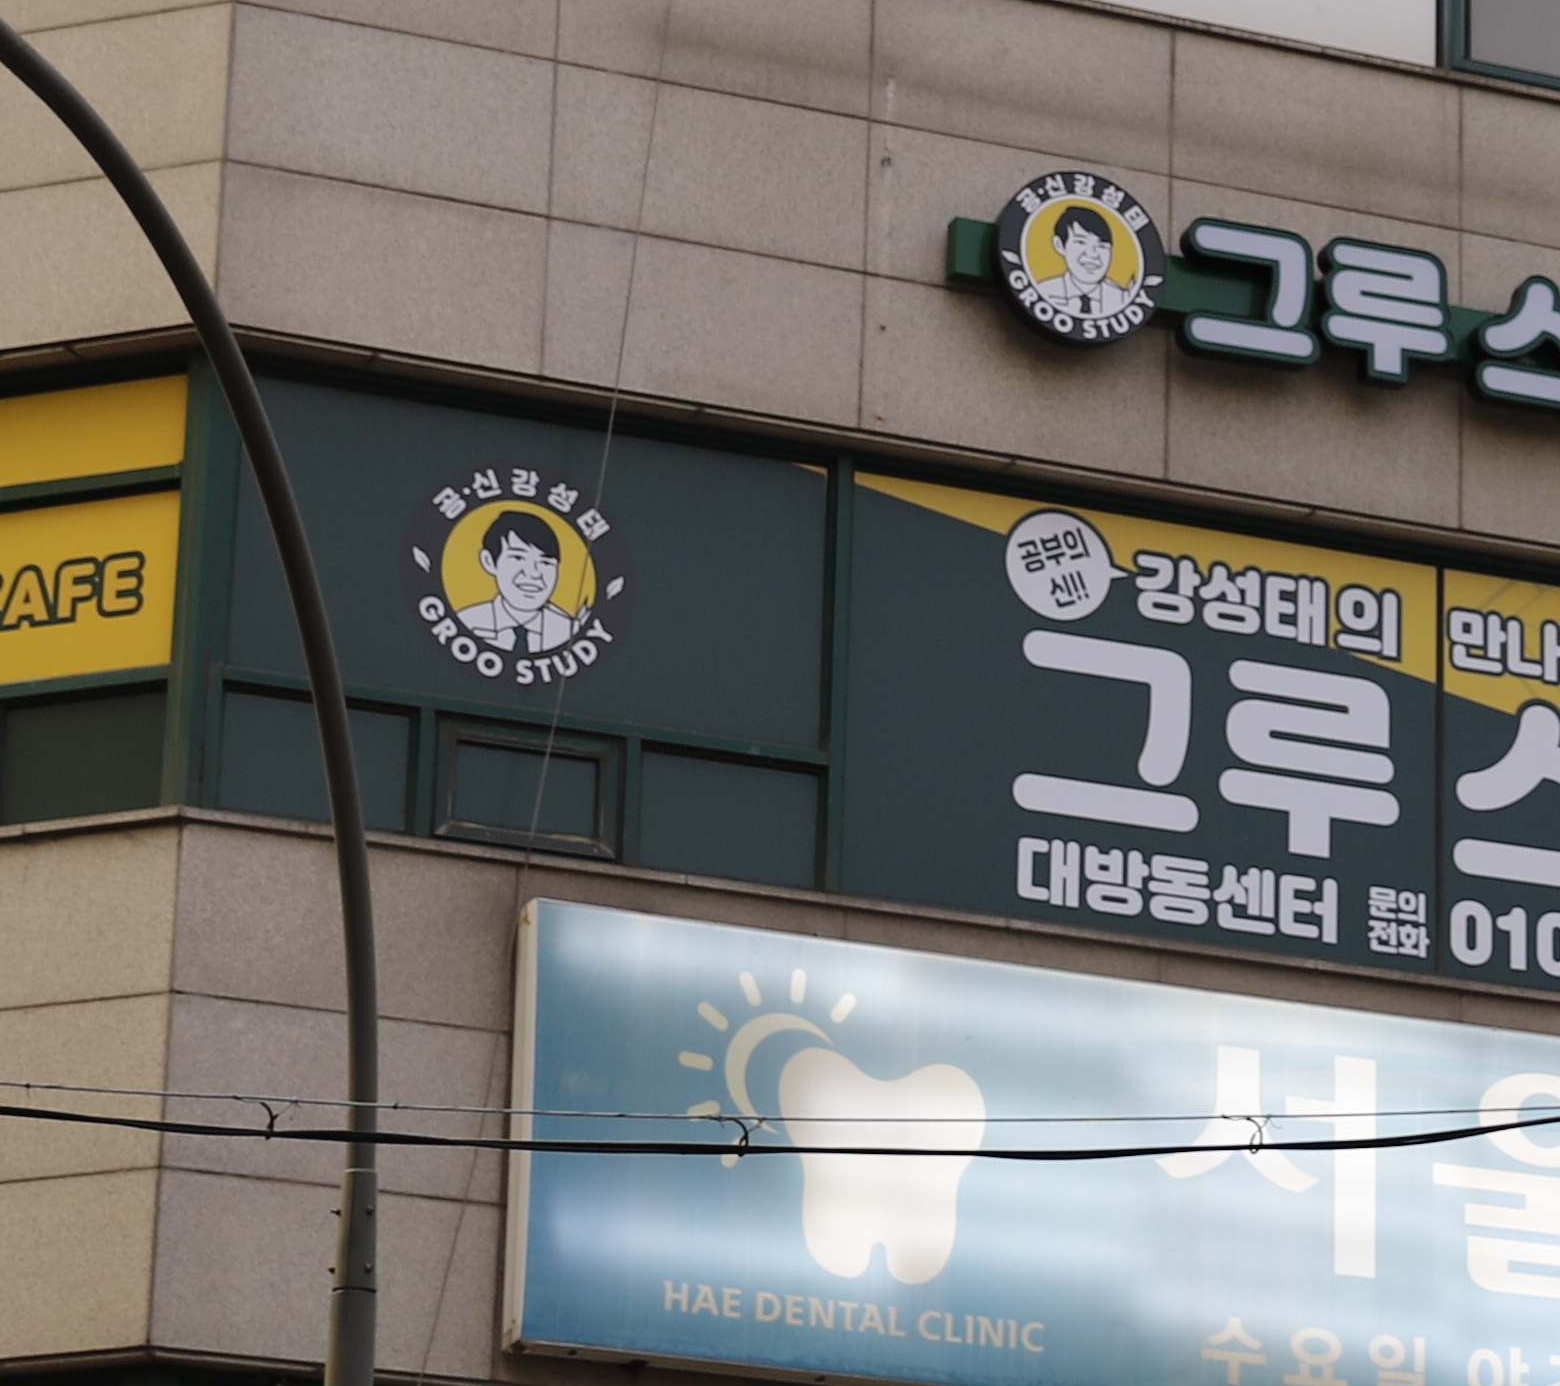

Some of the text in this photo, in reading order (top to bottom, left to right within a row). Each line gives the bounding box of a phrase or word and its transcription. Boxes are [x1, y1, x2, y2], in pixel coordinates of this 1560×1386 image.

[1006, 268, 1158, 342] GROO STUDY
[1185, 220, 1453, 381] 그루
[510, 467, 611, 542] 강성태
[1016, 525, 1090, 574] 공부의
[418, 595, 614, 686] GROO STUDY
[1136, 553, 1402, 661] 강성태의
[1012, 629, 1401, 859] 그루
[1016, 836, 1340, 946] 대방동센터
[1368, 885, 1427, 923] 문의
[1367, 919, 1430, 958] 전화
[662, 1278, 1047, 1354] HAE DENTAL CLINIC
